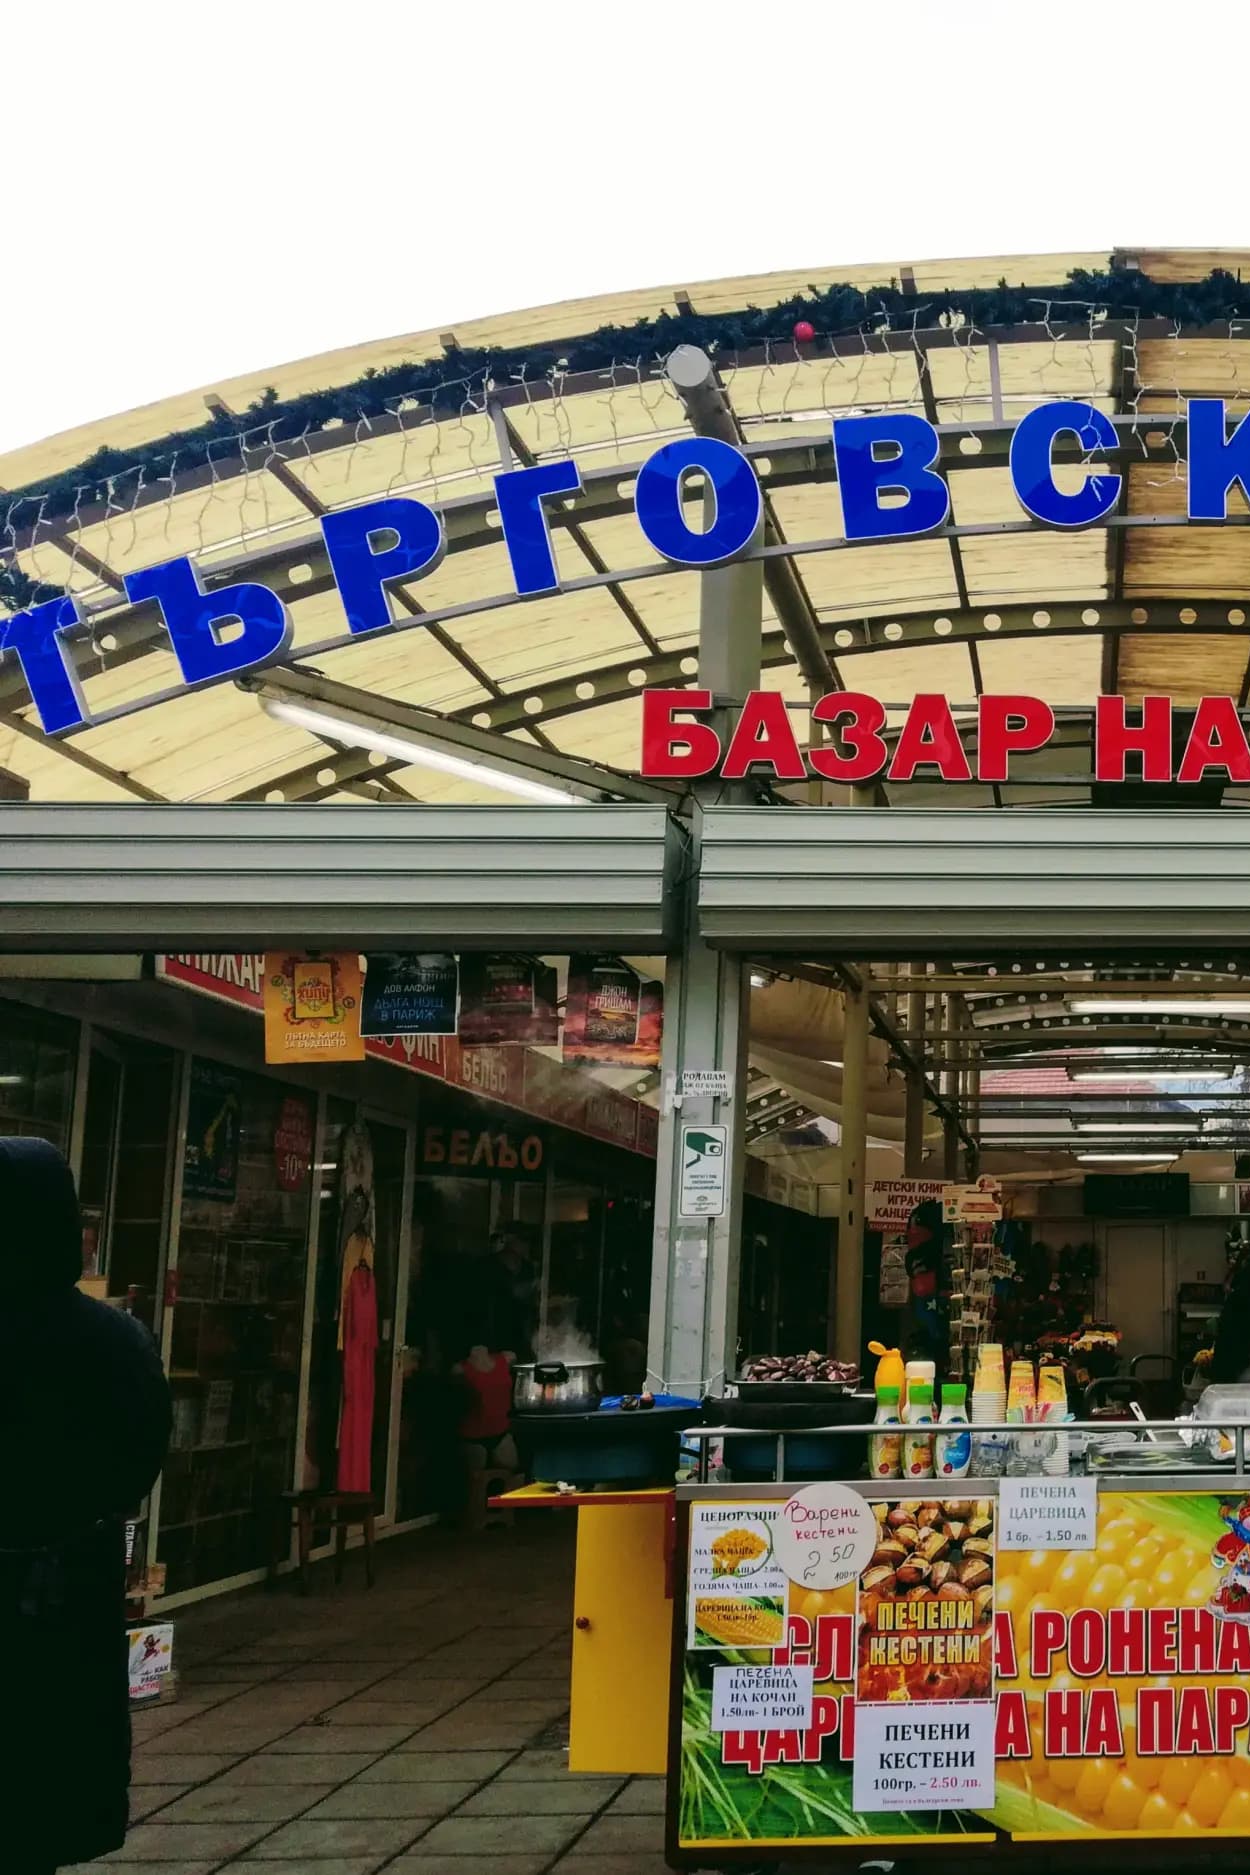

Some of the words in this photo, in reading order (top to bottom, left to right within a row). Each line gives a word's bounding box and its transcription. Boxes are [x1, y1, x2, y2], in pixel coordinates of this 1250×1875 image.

[641, 688, 1055, 783] БАЗАР
[392, 1008, 436, 1020] ПАРИЖ
[873, 1180, 916, 1193] ДЕТСКИ
[1019, 1487, 1077, 1499] ПЕЧЕНА
[784, 1500, 860, 1531] Варени
[1009, 1507, 1087, 1520] ЦАРЕВИЦА
[794, 1526, 859, 1541] кестени
[1006, 1531, 1012, 1541] 1
[1045, 1530, 1072, 1541] 1.50
[803, 1551, 821, 1580] 2
[830, 1543, 855, 1562] 50
[877, 1600, 974, 1631] ПЕЧЕНИ
[869, 1634, 980, 1666] КЕСТЕНИ
[729, 1679, 798, 1690] ЦАРЕВИЦА
[730, 1692, 748, 1703] НА
[752, 1692, 796, 1703] КОЧАН
[772, 1704, 805, 1717] БРОЙ
[1045, 1688, 1124, 1757] НА
[884, 1723, 971, 1741] ПЕЧЕНИ
[879, 1750, 976, 1769] КЕСТЕНИ
[873, 1777, 917, 1792] 100гр.
[930, 1776, 958, 1788] 2.50
[961, 1778, 982, 1788] лв.
